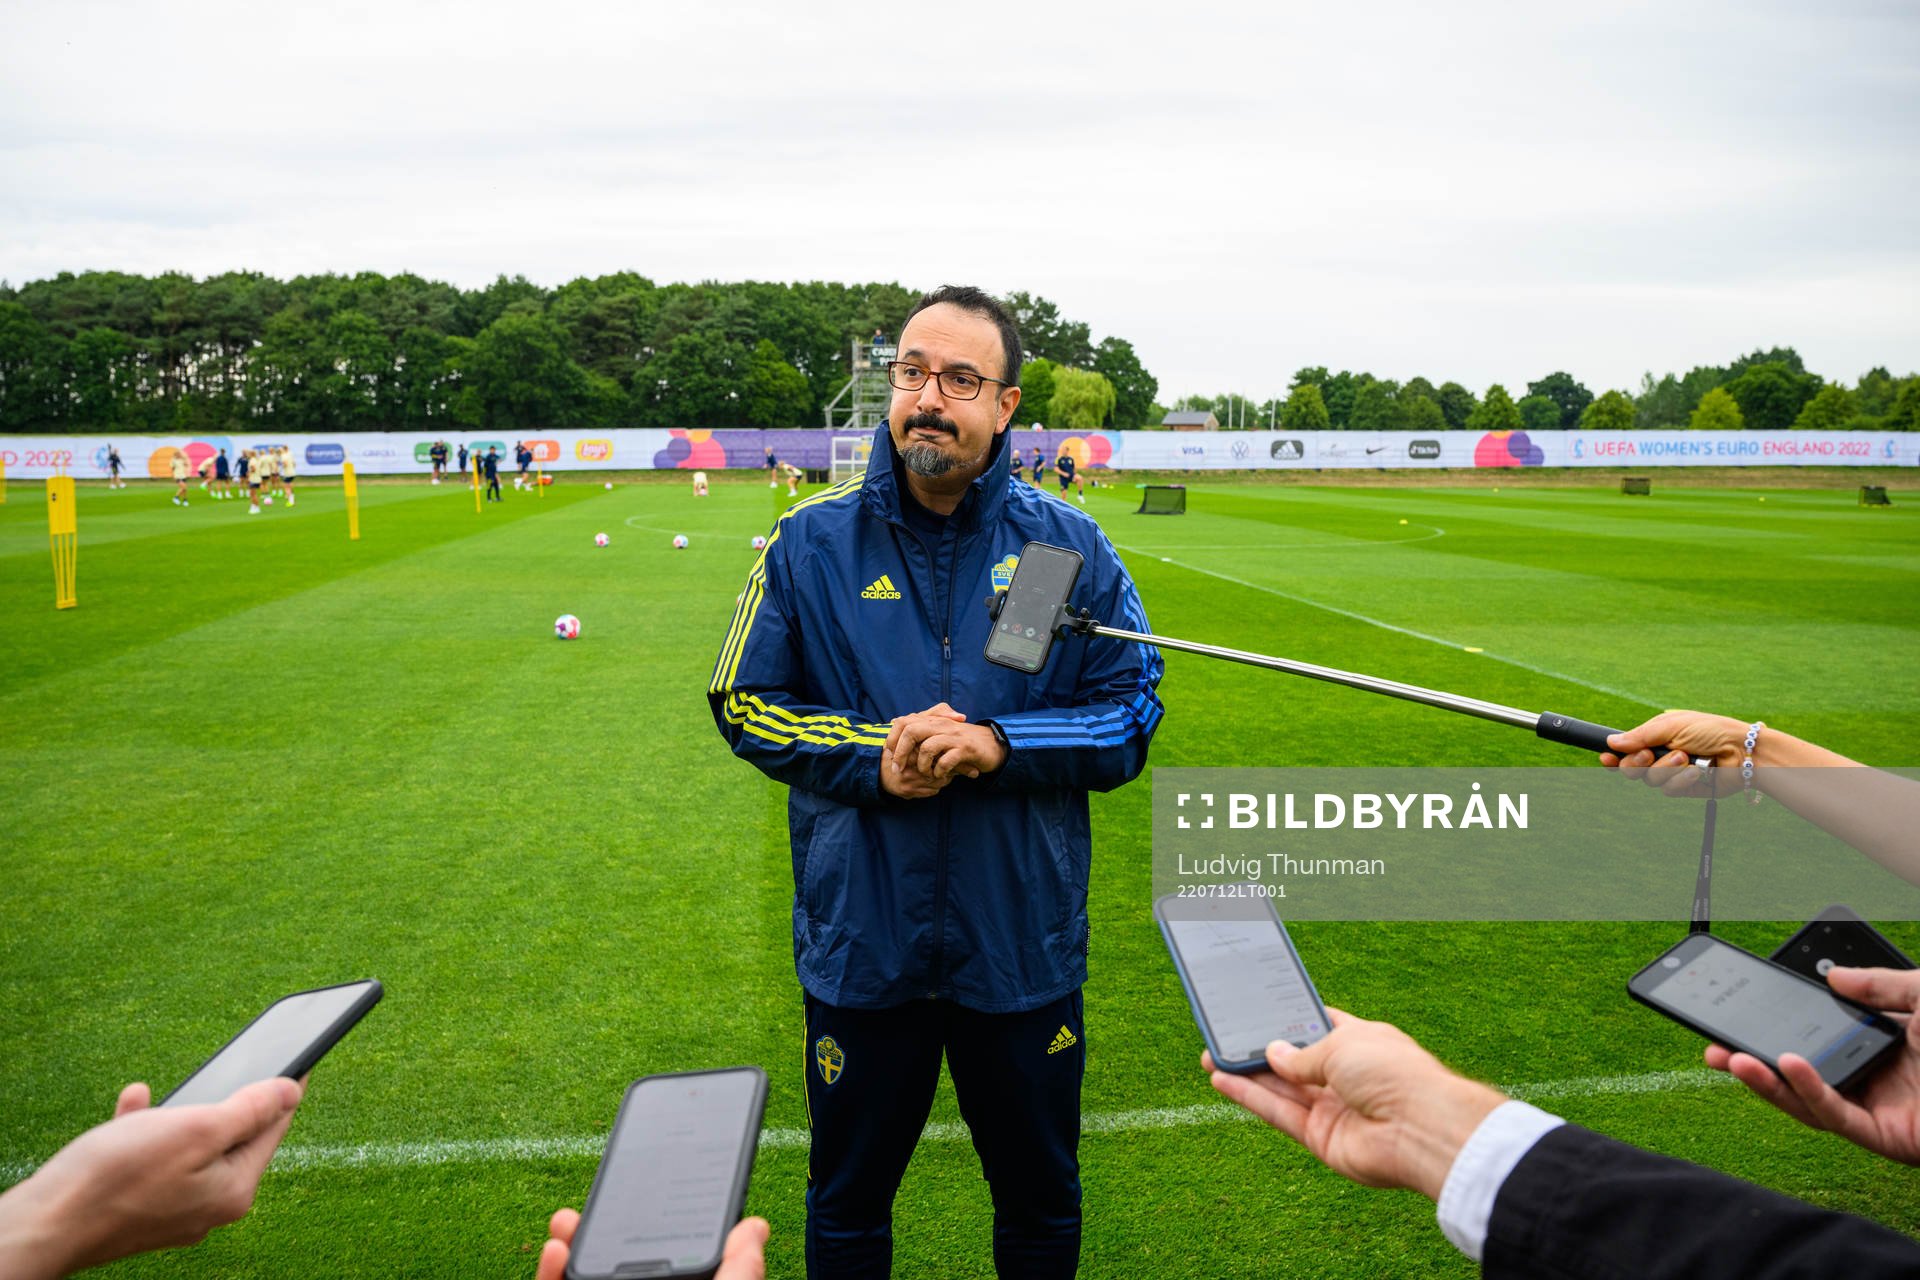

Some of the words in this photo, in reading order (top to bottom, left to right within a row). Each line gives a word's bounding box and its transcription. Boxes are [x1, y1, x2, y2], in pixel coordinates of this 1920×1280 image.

[1182, 446, 1204, 455] VISA
[1594, 441, 1636, 456] UEFA
[1640, 441, 1713, 455] WOMEN'S
[1717, 441, 1759, 456] EURO
[1763, 441, 1834, 456] ENGLAND
[1838, 441, 1871, 456] 2022
[25, 450, 73, 467] 2022
[861, 590, 901, 600] adidas
[1047, 1035, 1077, 1054] adidas
